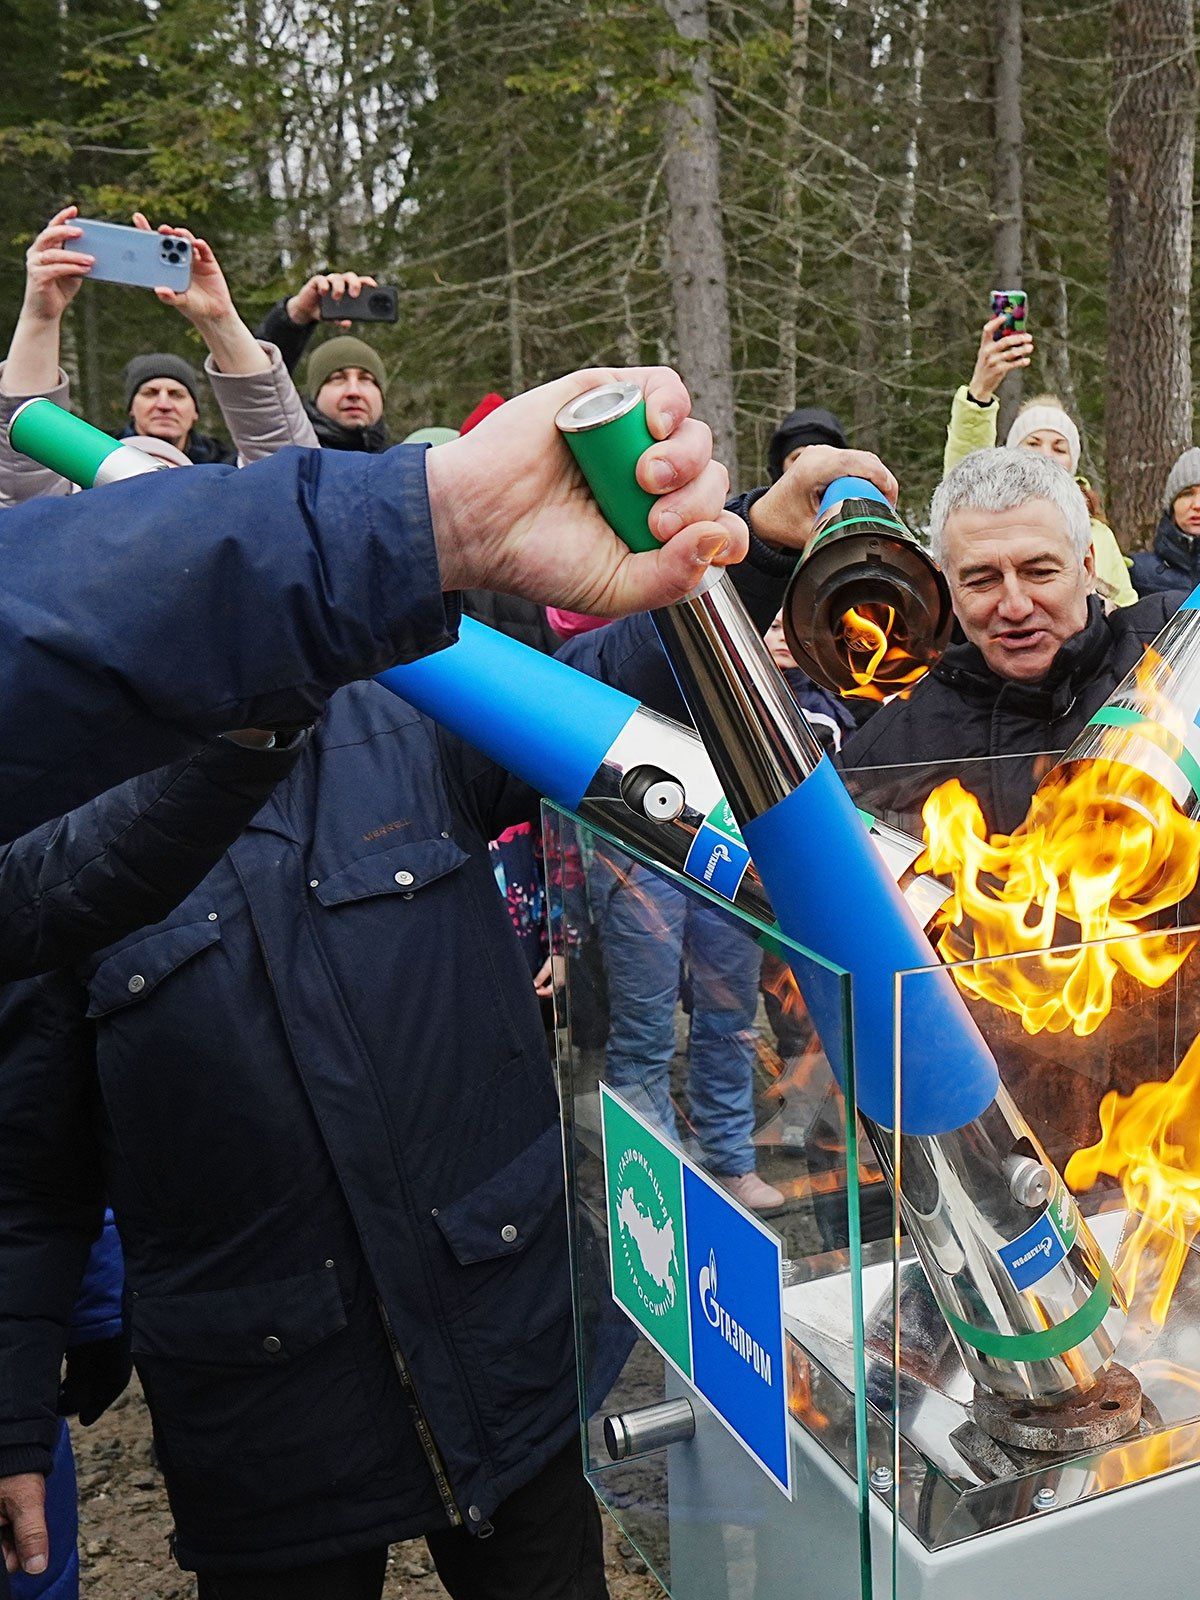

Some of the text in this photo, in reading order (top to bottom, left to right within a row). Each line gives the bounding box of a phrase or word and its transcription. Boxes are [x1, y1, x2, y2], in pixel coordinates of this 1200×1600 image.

[618, 1148, 669, 1219] ГАЗИФИКАЦИЯ
[632, 1277, 666, 1317] РОССИИ
[719, 1306, 772, 1386] ГАЗПРОМ
